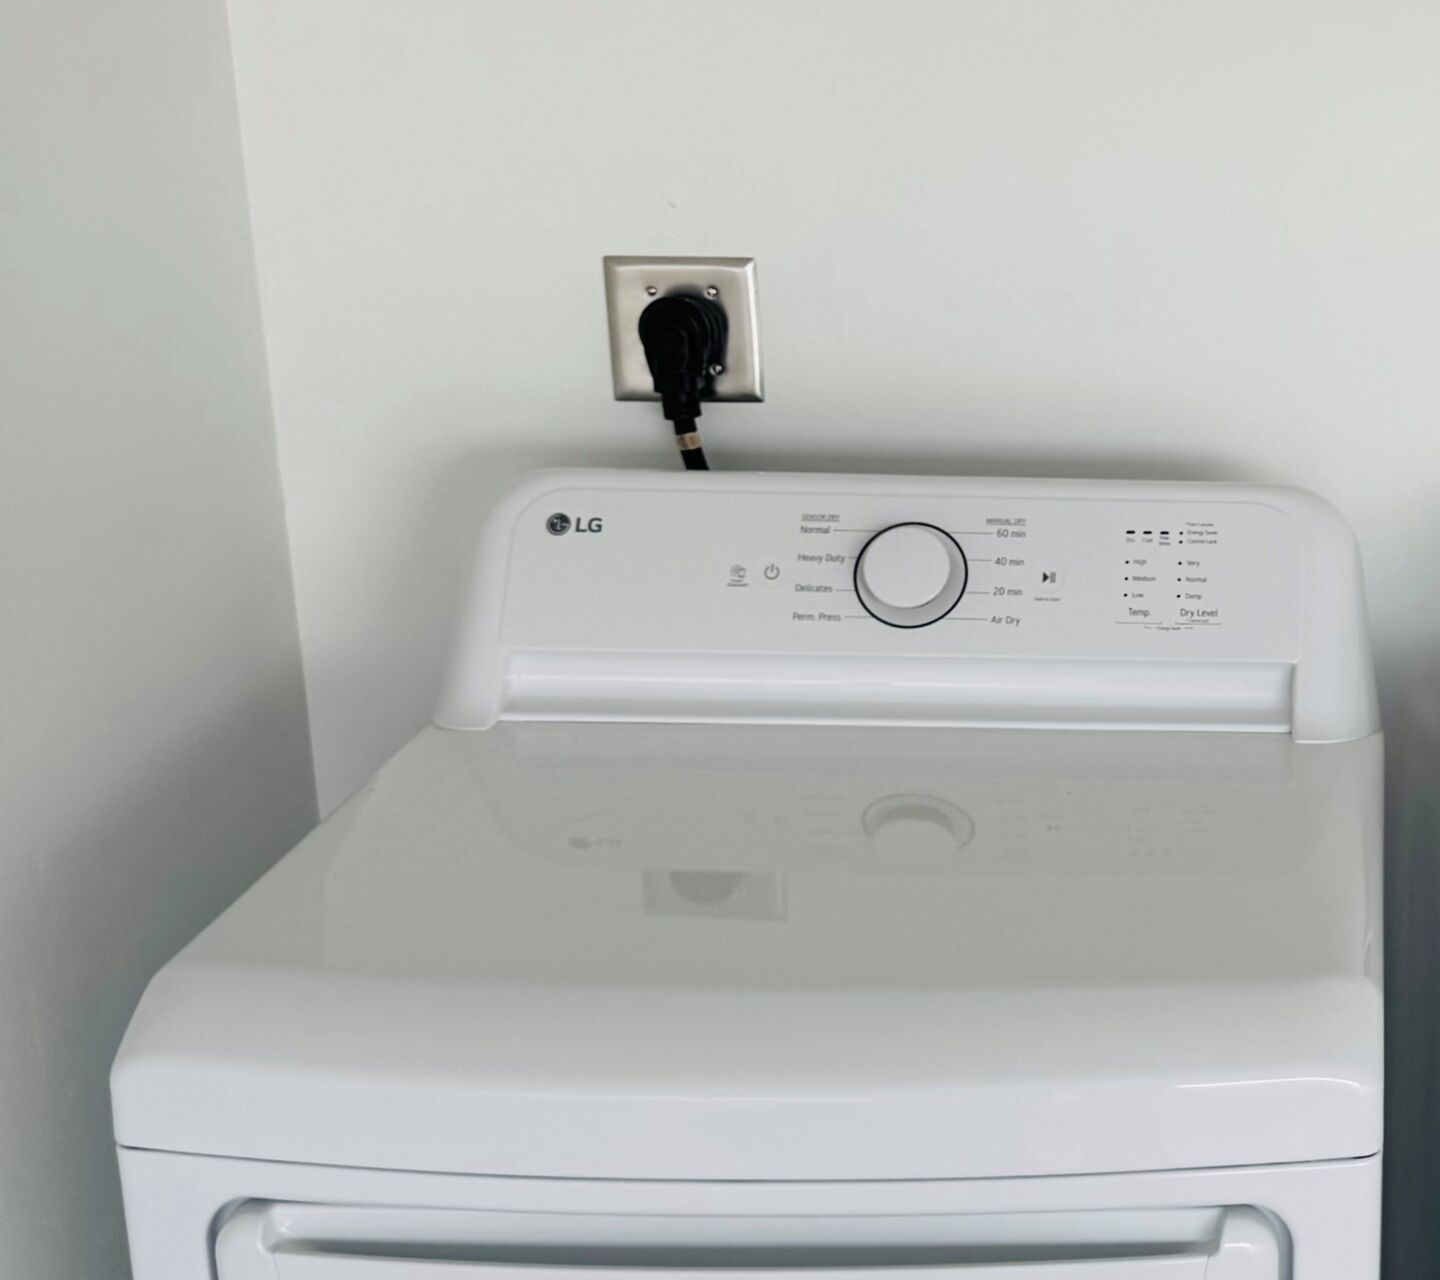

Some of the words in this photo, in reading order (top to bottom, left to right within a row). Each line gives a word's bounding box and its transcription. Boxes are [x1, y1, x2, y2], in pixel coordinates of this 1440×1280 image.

[575, 516, 603, 533] LG
[800, 525, 831, 534] Normal
[996, 528, 1009, 538] 60
[1010, 529, 1026, 538] min
[797, 553, 823, 564] Heavy
[825, 553, 846, 565] Duty
[994, 557, 1007, 566] 40
[1008, 558, 1025, 566] min
[794, 583, 833, 593] Delicates
[992, 586, 1006, 596] 20
[1007, 587, 1023, 596] min
[818, 612, 842, 621] Press
[1179, 608, 1194, 618] Dry
[1196, 609, 1219, 617] Level
[990, 616, 1004, 624] Air
[1005, 616, 1021, 627] Dry
